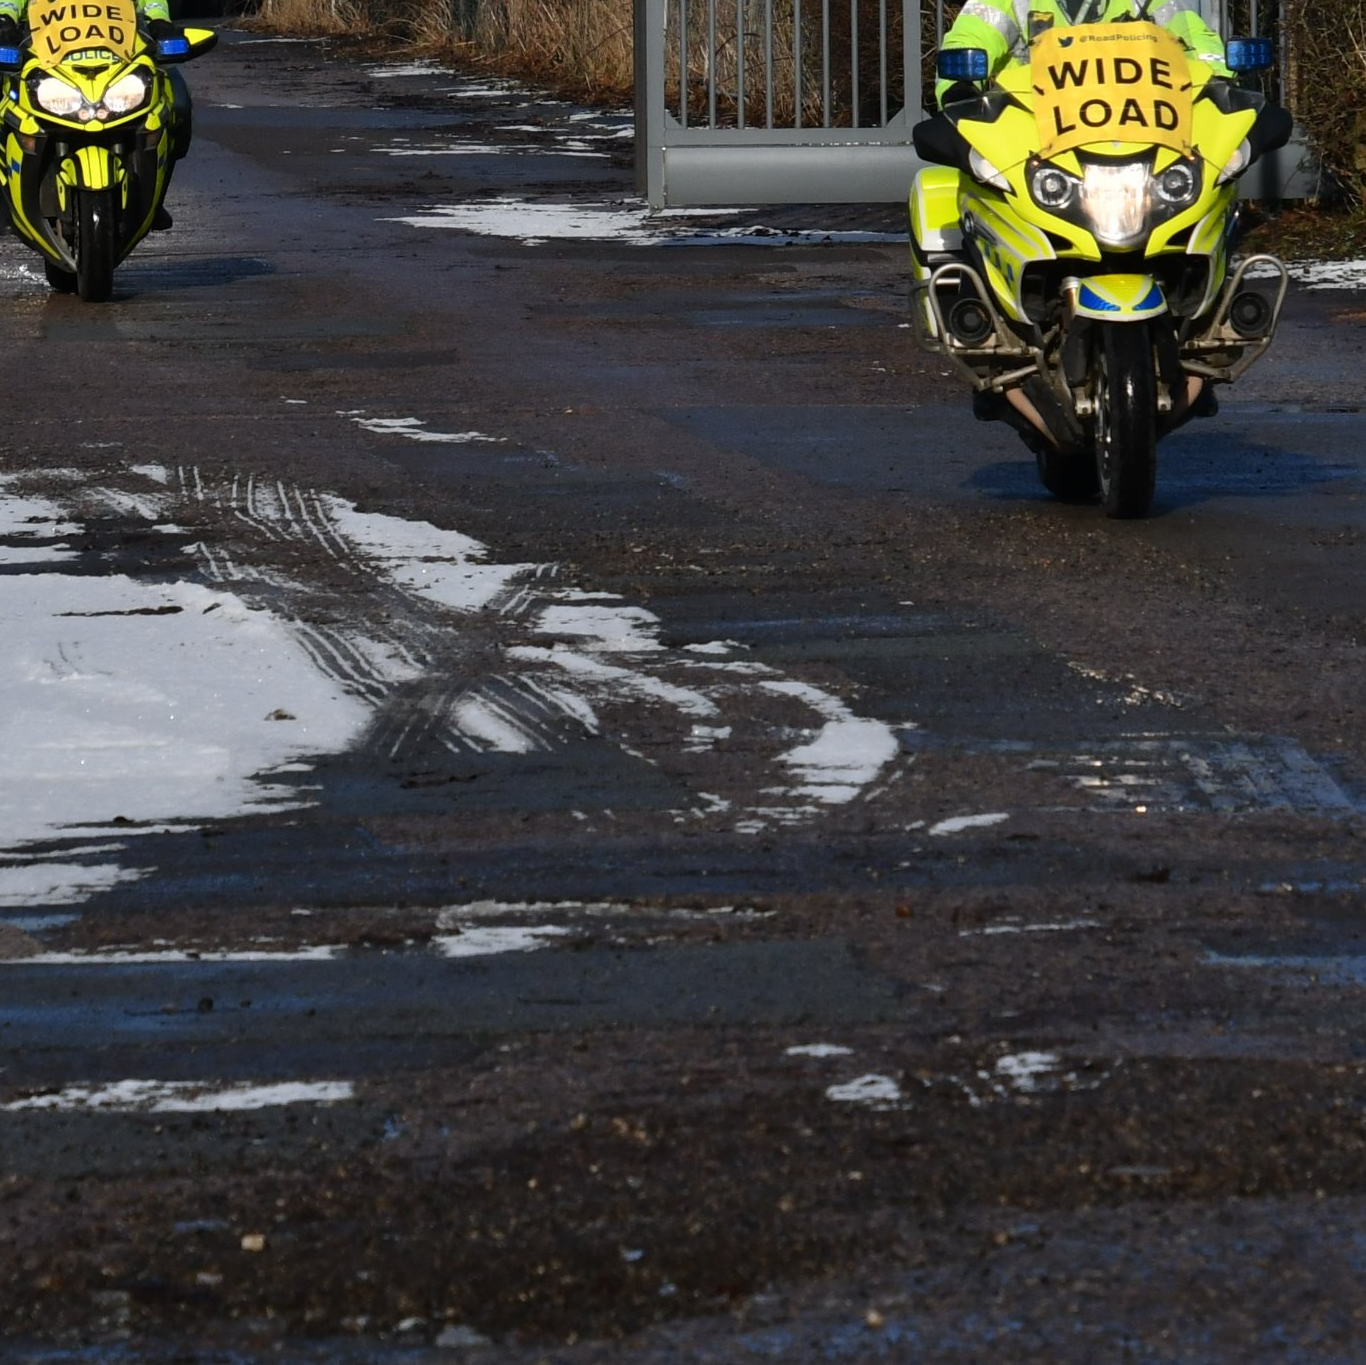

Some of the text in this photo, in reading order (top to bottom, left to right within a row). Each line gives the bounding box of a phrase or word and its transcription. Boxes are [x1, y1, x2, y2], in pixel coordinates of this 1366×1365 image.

[40, 4, 123, 26] WIDE
[46, 24, 125, 54] LOAD
[1079, 34, 1158, 43] @RoadPolicing
[1048, 58, 1173, 90] WIDE
[1053, 98, 1179, 136] LOAD
